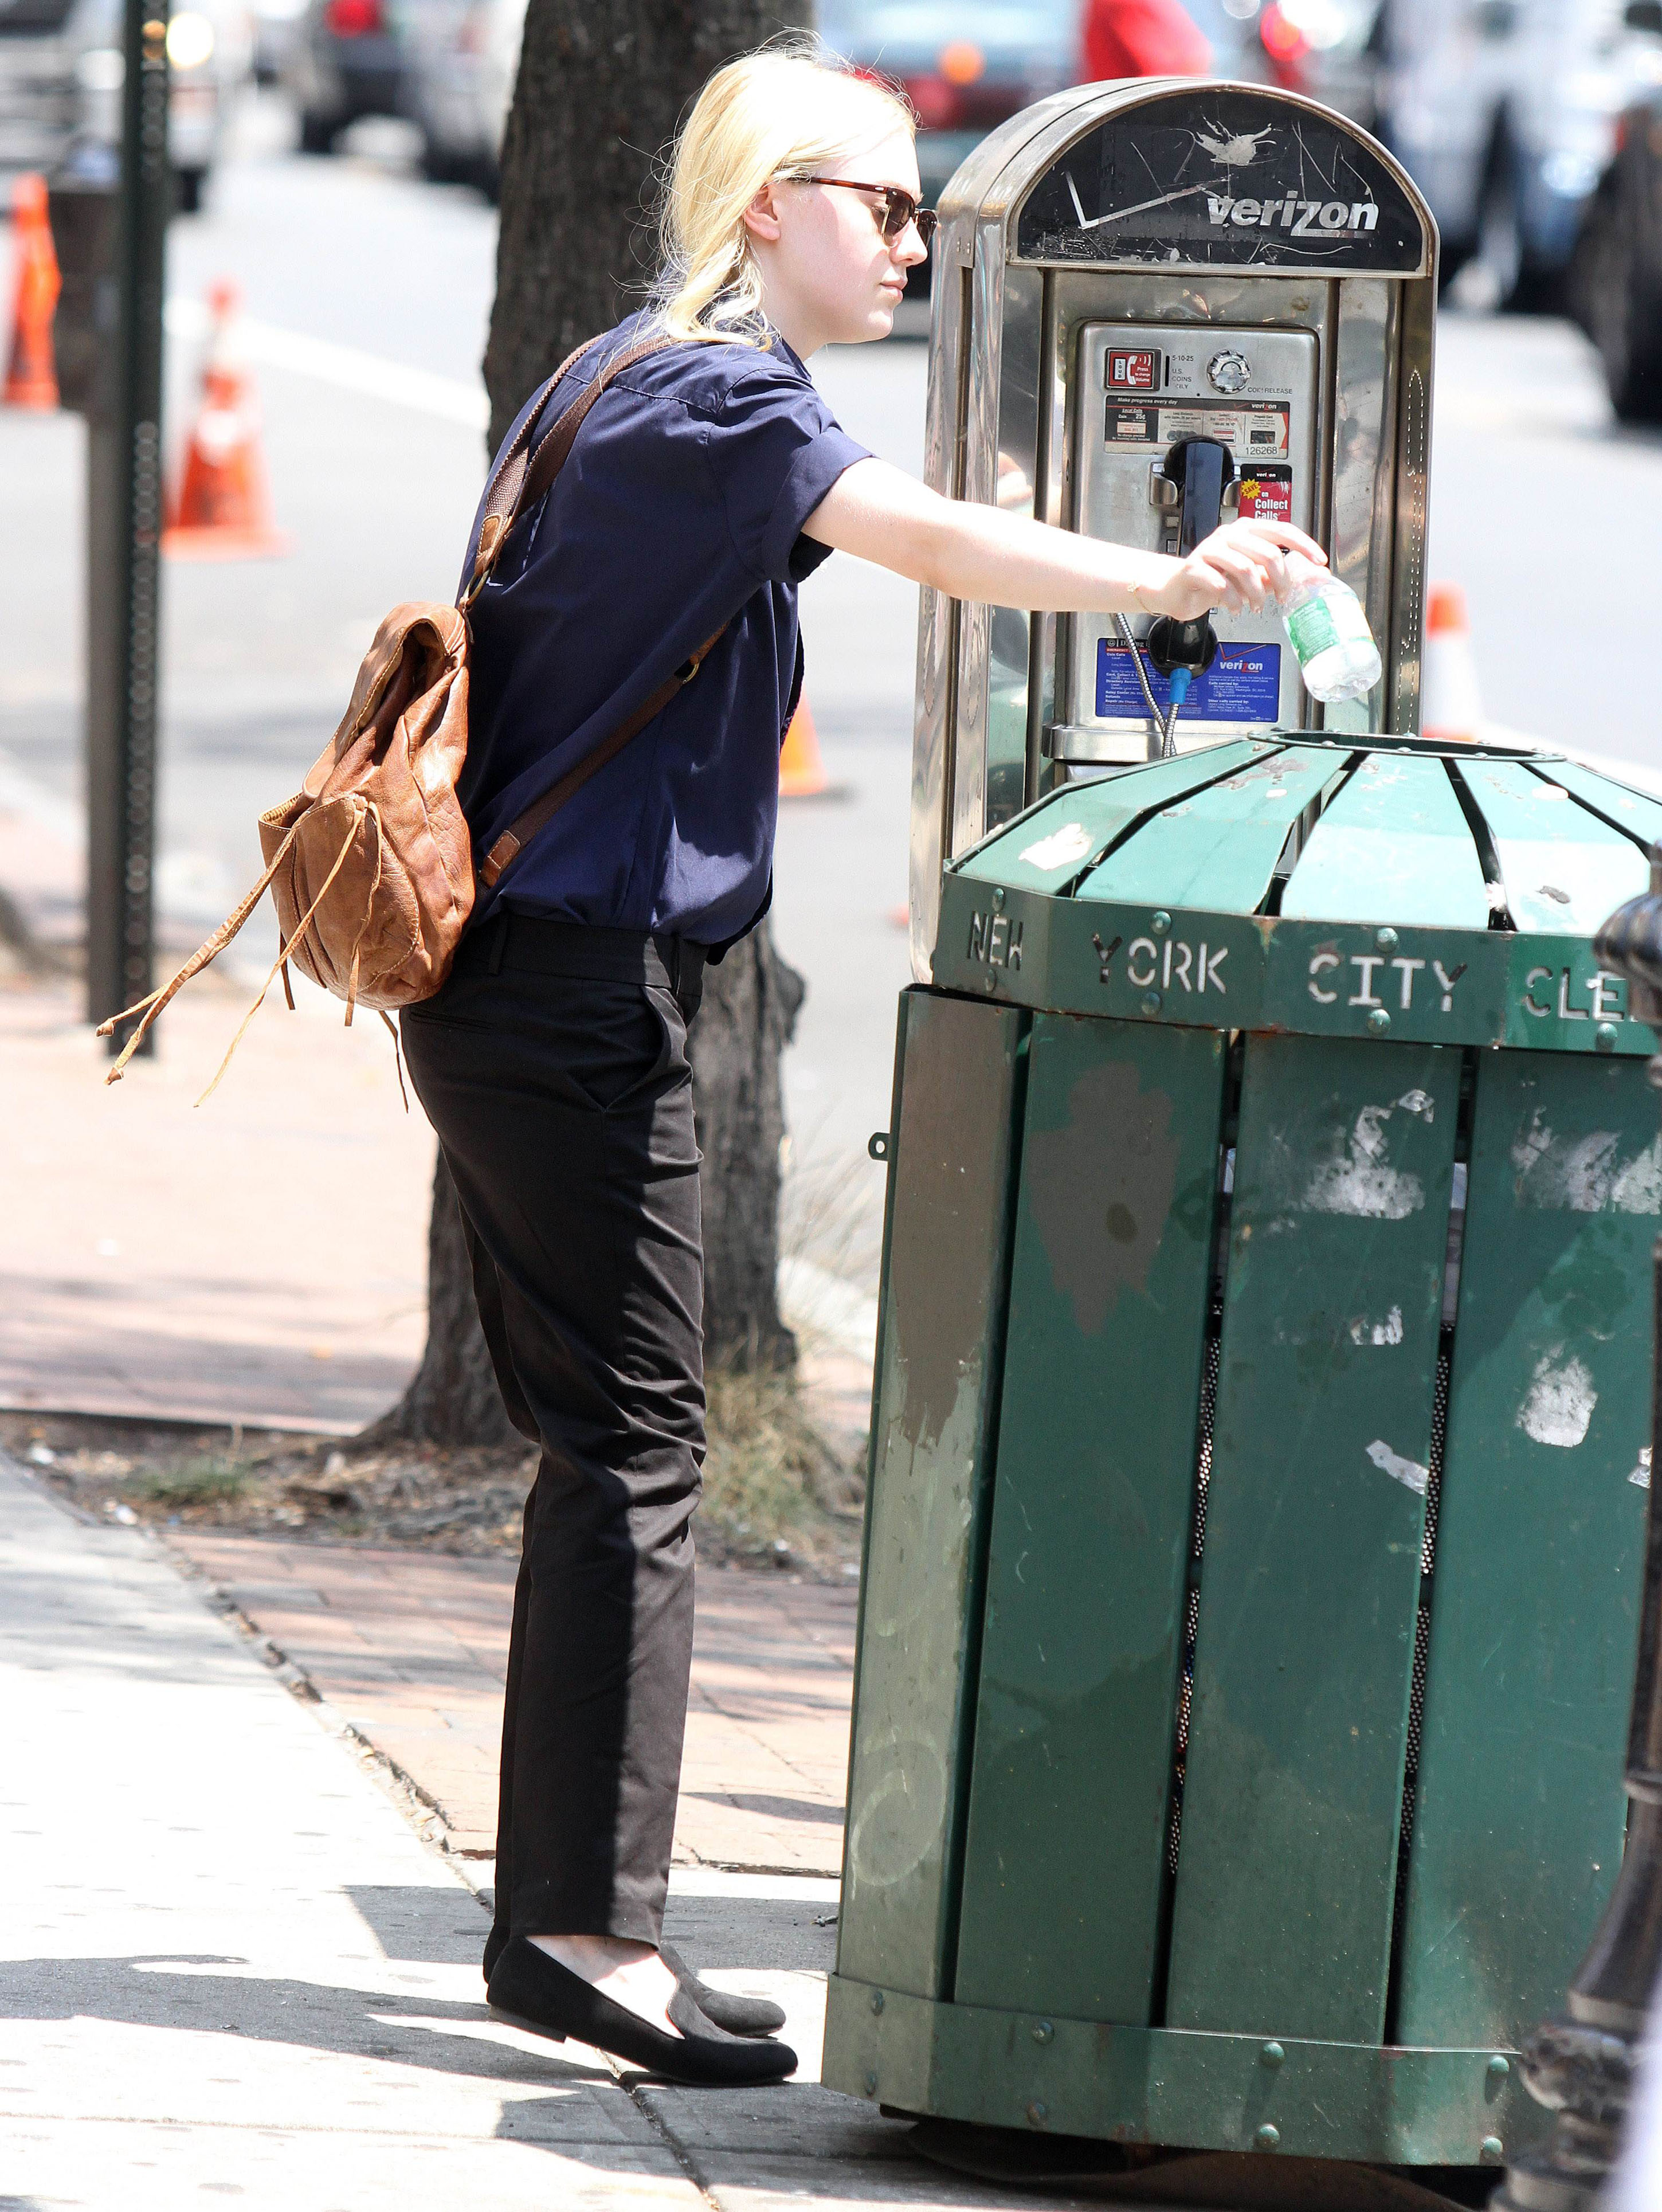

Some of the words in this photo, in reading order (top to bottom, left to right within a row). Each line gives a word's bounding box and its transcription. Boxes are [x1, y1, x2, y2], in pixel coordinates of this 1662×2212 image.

[1207, 190, 1379, 237] verizon
[1251, 402, 1277, 410] verizon
[1245, 446, 1277, 455] 126268
[1244, 483, 1259, 494] SAVE
[1255, 499, 1288, 510] Collect
[1255, 510, 1279, 520] Calls
[1220, 659, 1263, 673] verizon
[967, 910, 1024, 971] NEW
[1092, 933, 1229, 994] YORK
[1308, 953, 1468, 1012] CITY
[1522, 966, 1638, 1023] CLE
